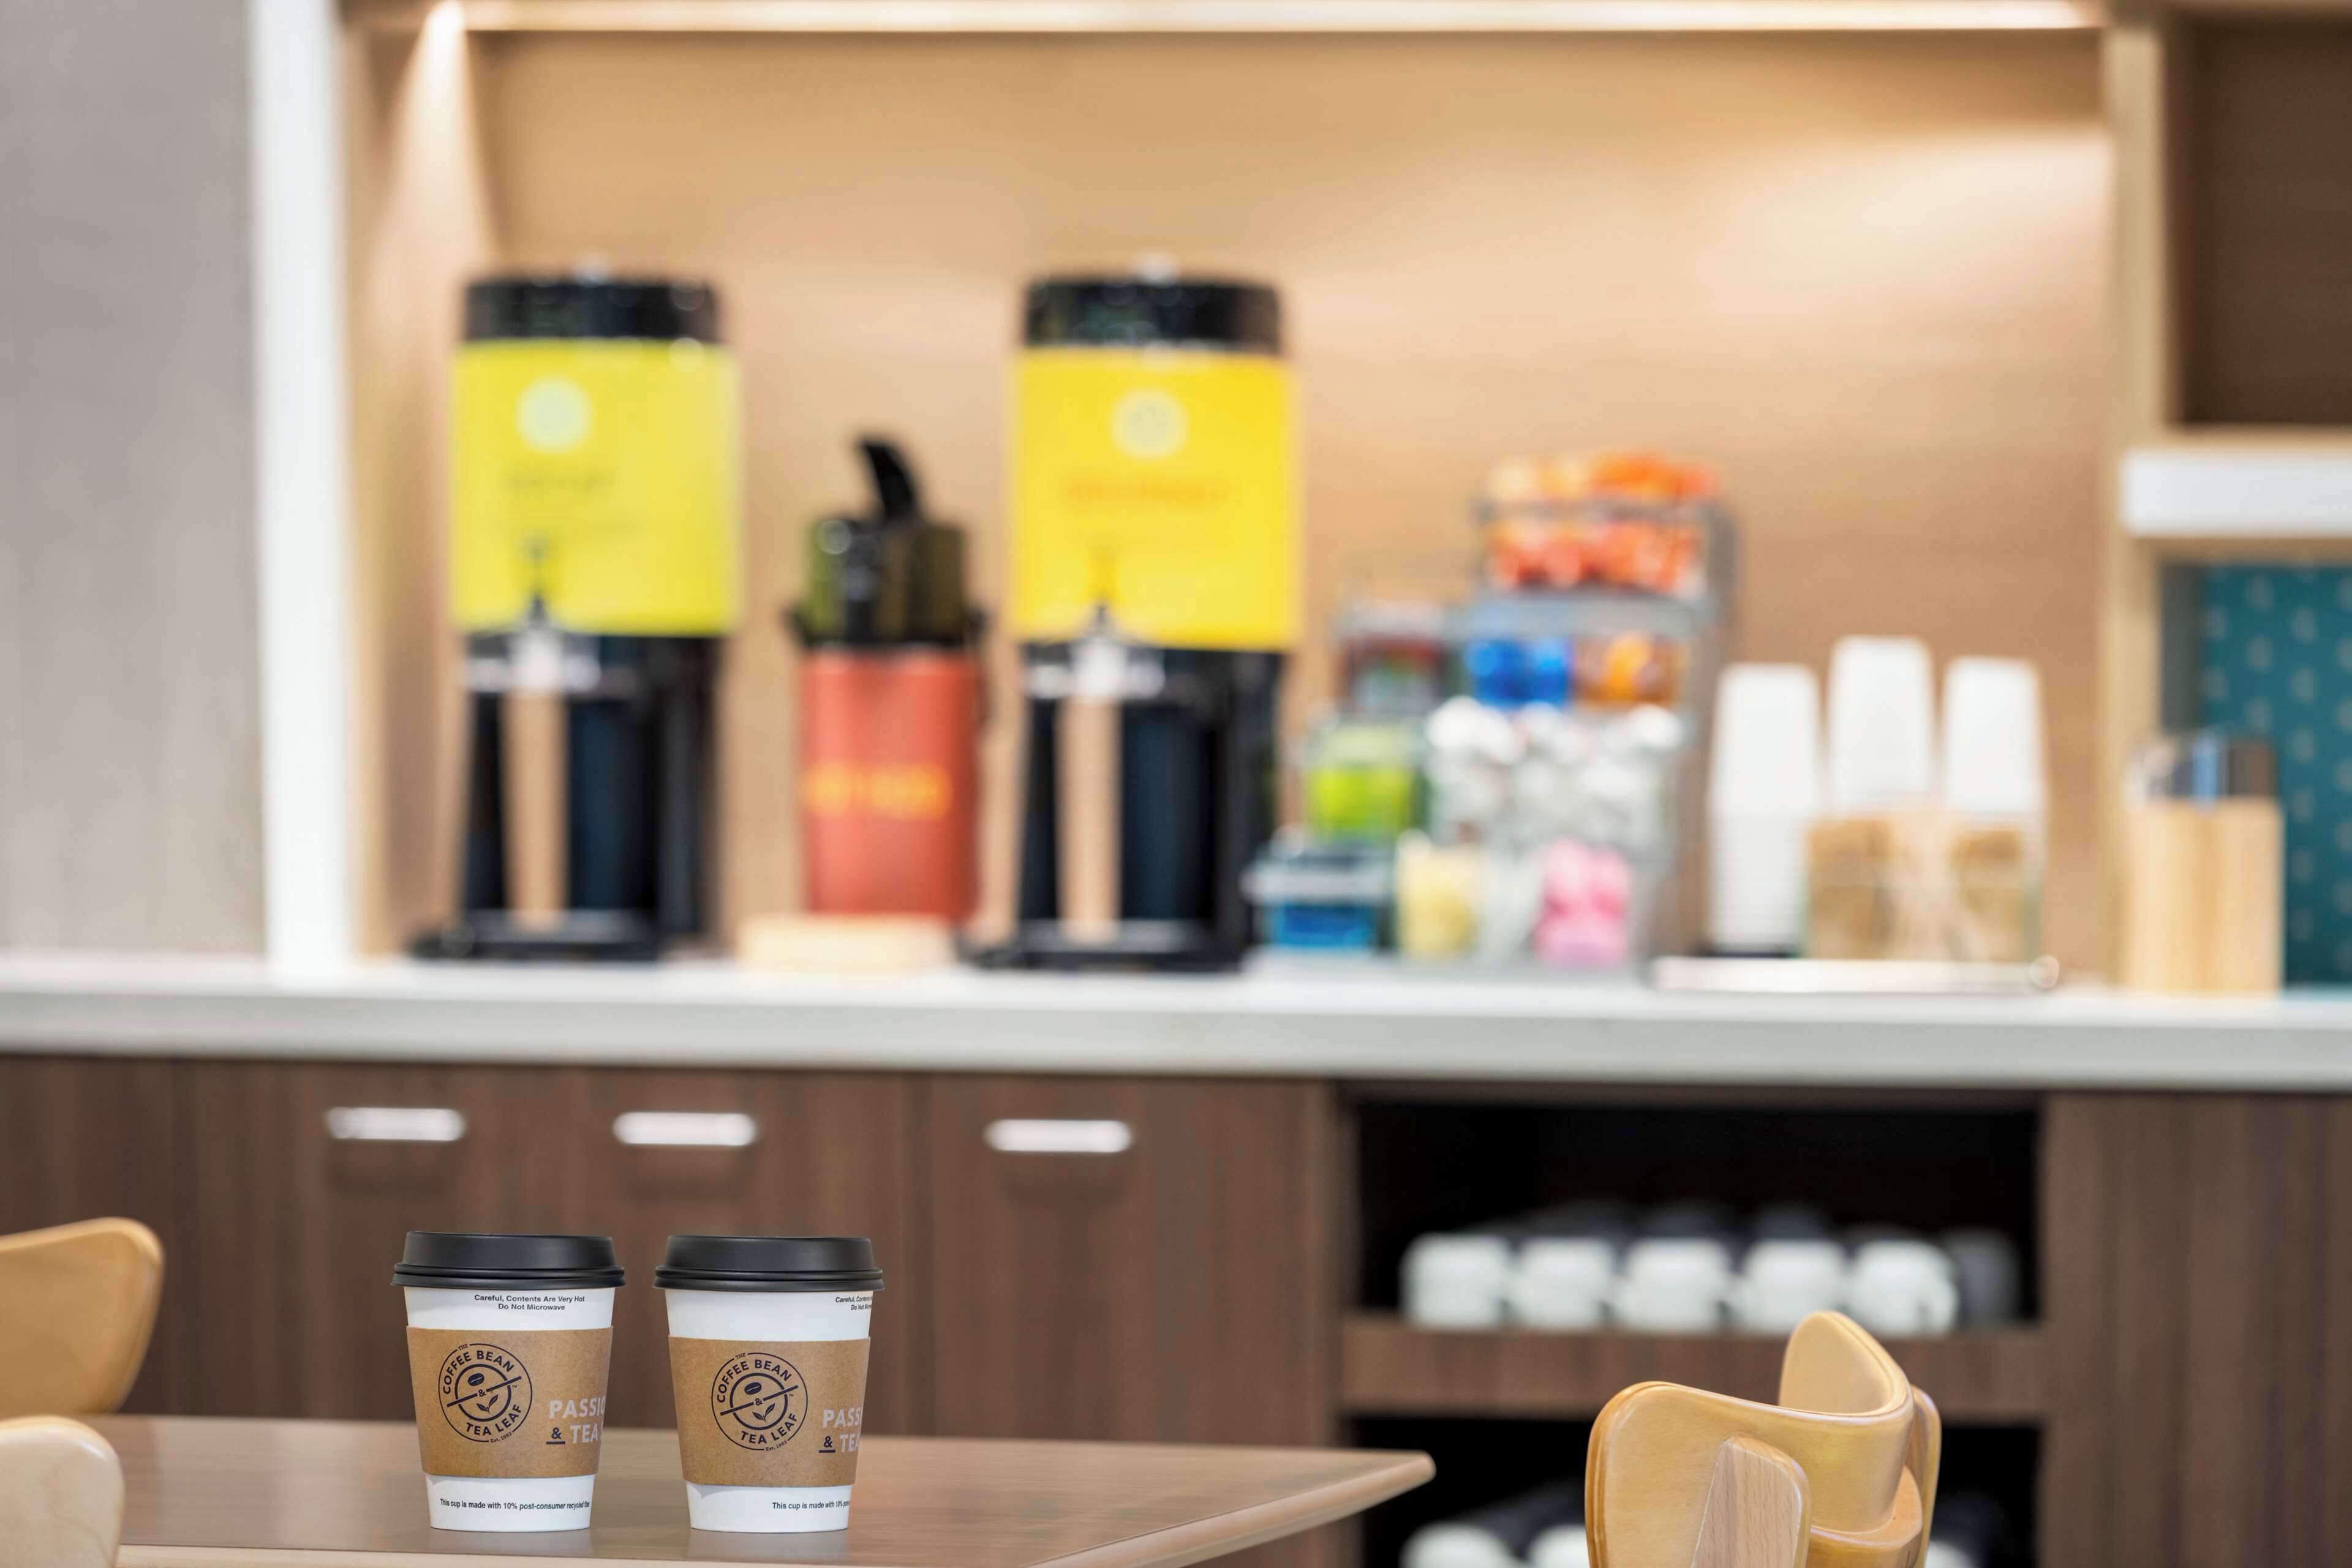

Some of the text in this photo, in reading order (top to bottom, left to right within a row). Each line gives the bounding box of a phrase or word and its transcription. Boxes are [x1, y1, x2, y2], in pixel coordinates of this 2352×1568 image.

[443, 1350, 514, 1395] COFFEE BEAN
[717, 1359, 792, 1403] COFFEE BEAN
[466, 1404, 522, 1436] TEA LEAF
[551, 1427, 562, 1439] &
[570, 1423, 598, 1444] TEA
[741, 1413, 797, 1444] TEA LEAF
[823, 1436, 833, 1448] &
[519, 1502, 566, 1511] post-consumer
[566, 1501, 584, 1510] recycled
